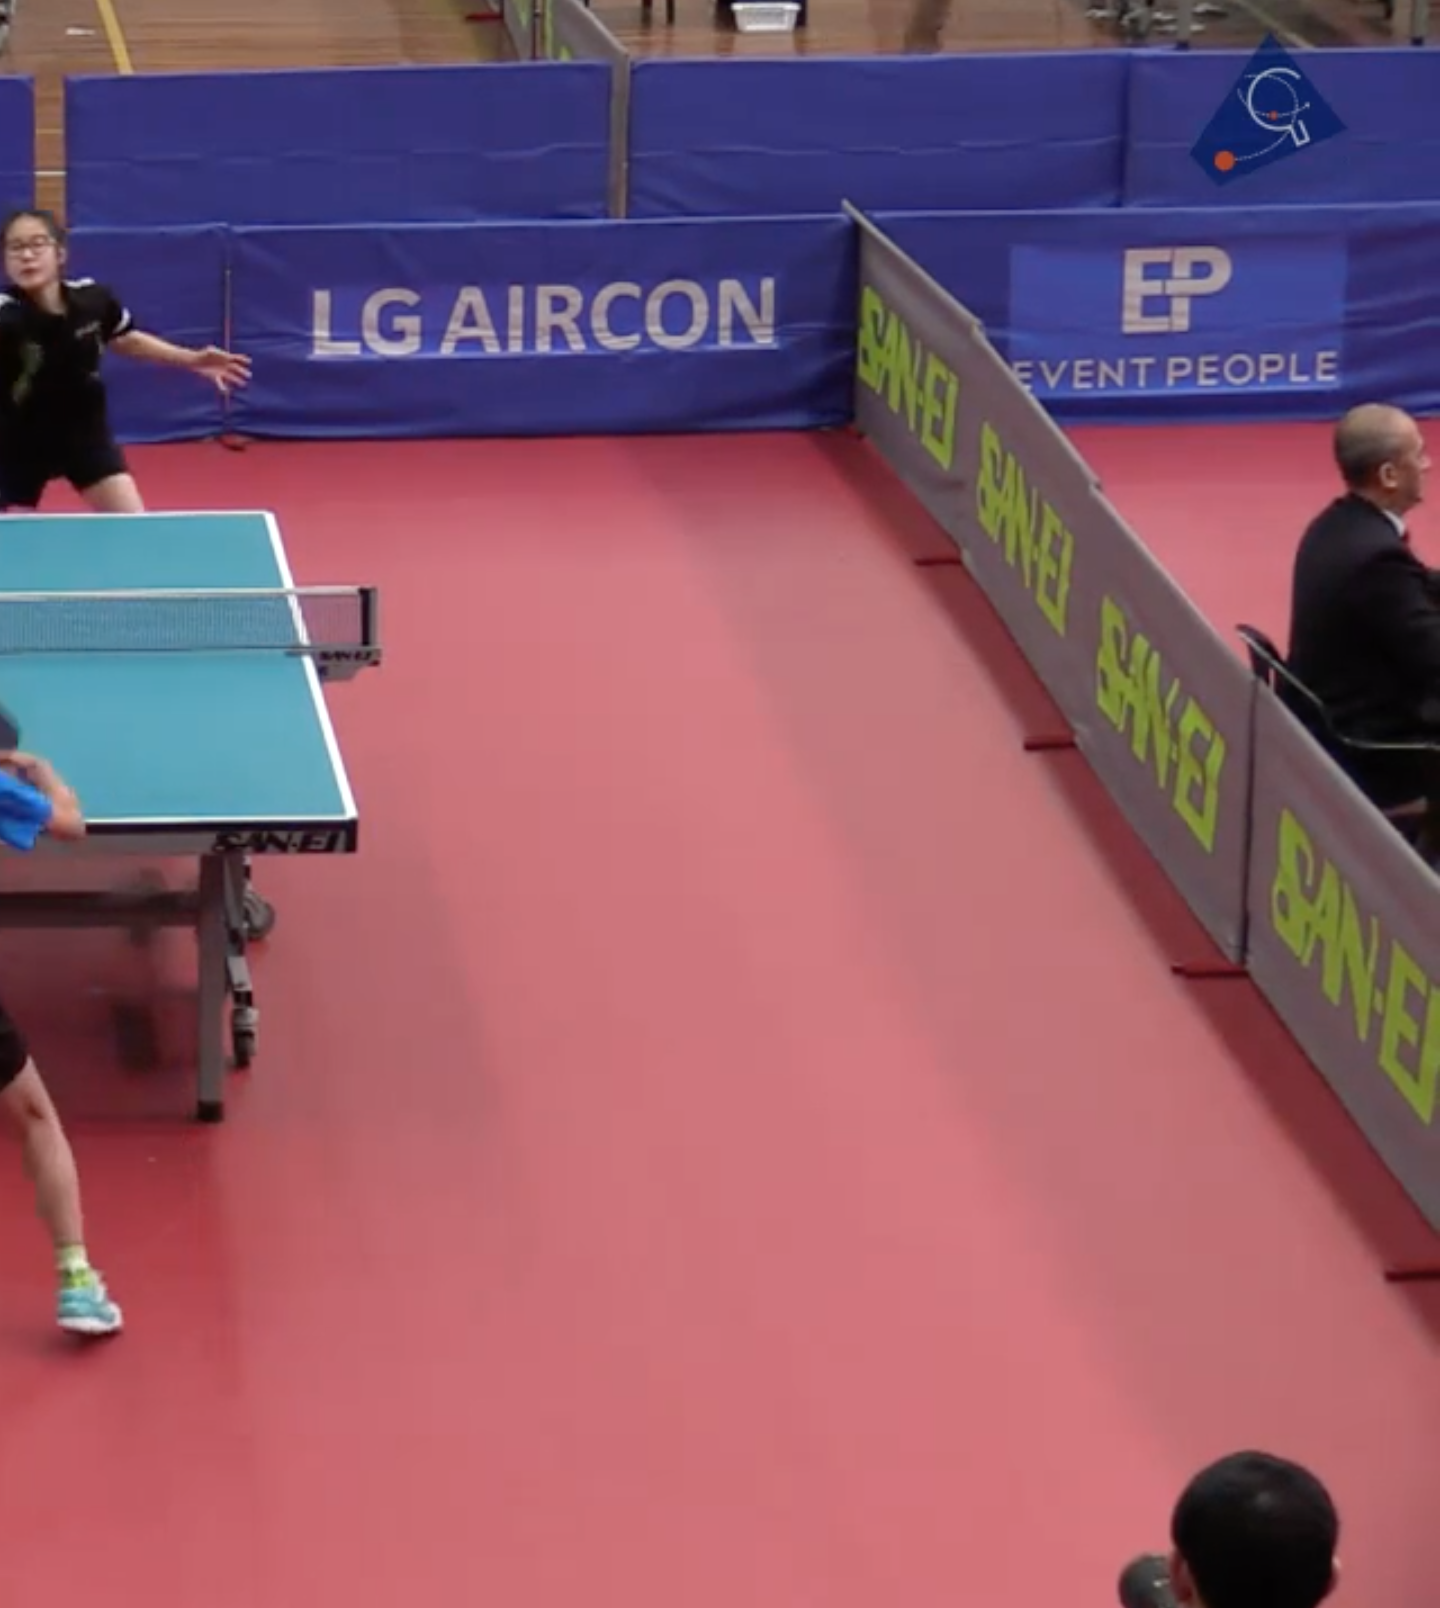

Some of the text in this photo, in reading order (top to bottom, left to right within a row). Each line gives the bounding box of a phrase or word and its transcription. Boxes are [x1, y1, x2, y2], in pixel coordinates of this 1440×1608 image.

[313, 276, 775, 355] LG AIRCON
[1122, 245, 1233, 335] EP
[857, 285, 958, 471] SAN-EI
[1012, 351, 1339, 391] EVENT PEOPLE
[977, 421, 1074, 638] SAN-EI
[1096, 595, 1225, 855] SAN-EI
